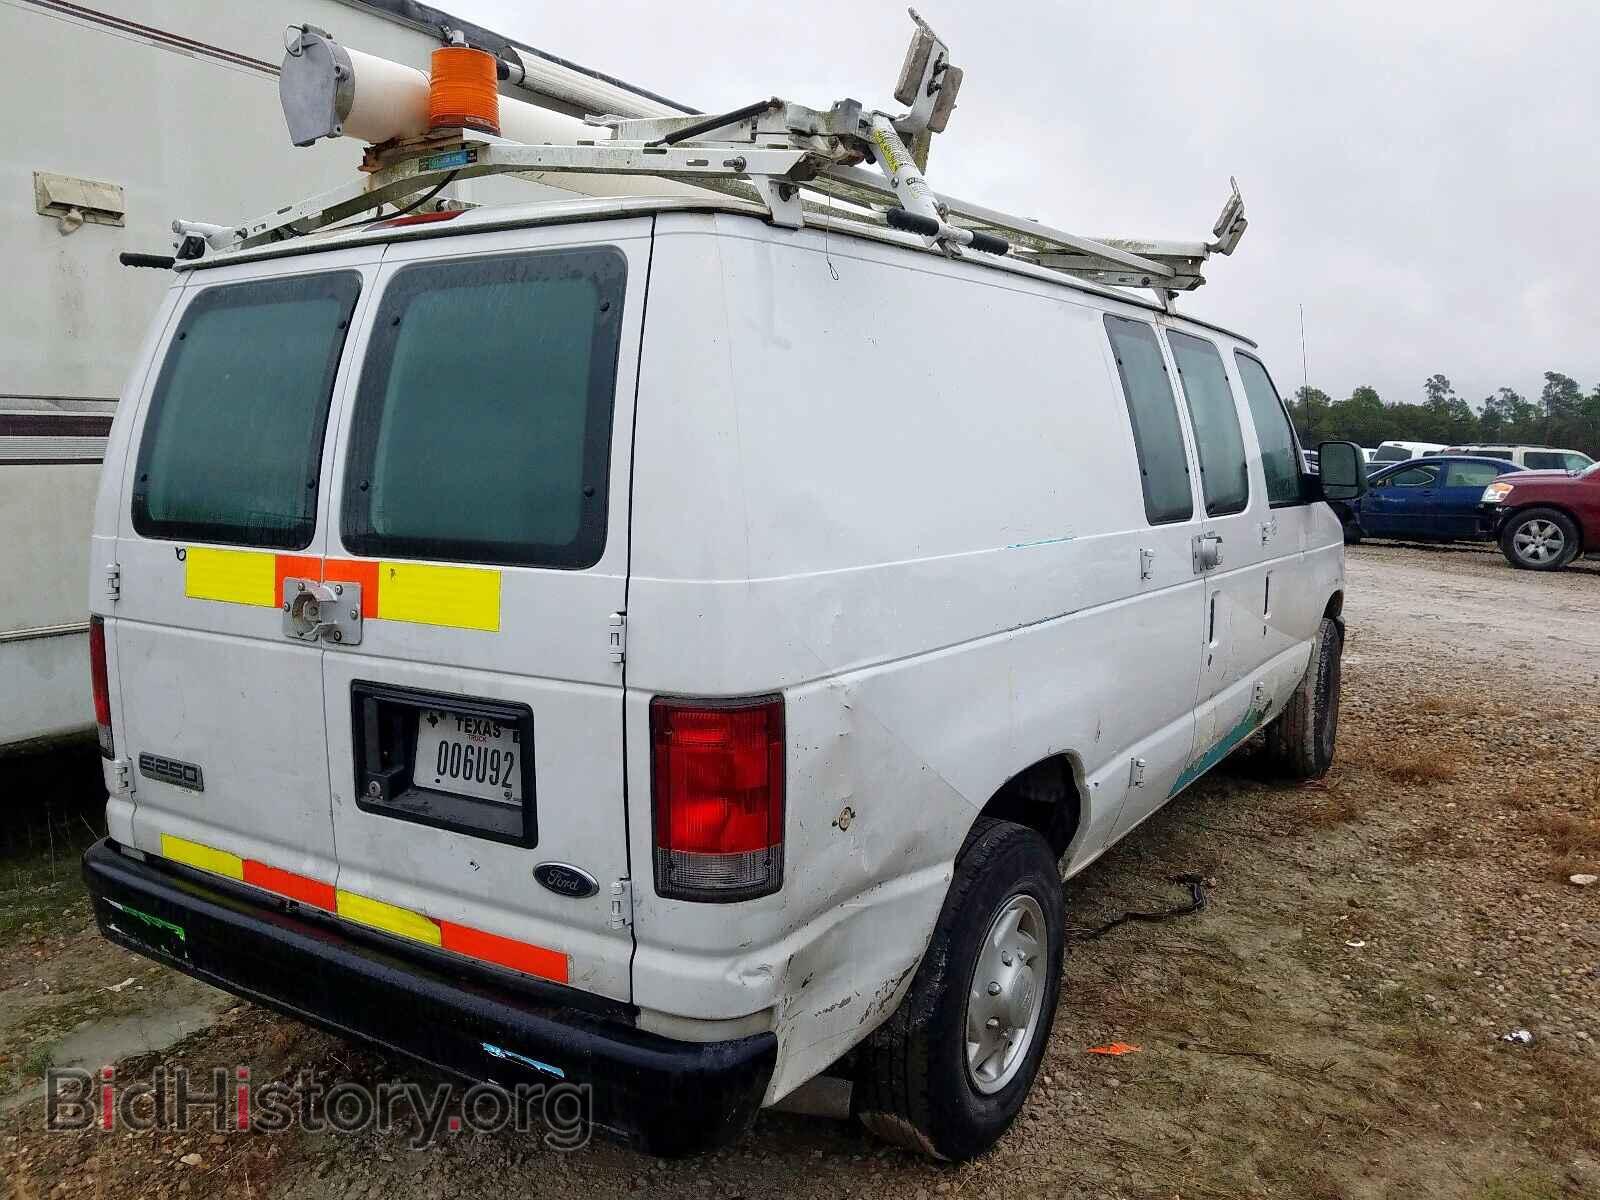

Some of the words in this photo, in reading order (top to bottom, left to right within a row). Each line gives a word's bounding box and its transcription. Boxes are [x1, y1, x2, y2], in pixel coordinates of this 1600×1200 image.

[455, 717, 502, 739] TEXAS
[140, 754, 199, 783] E250
[436, 740, 515, 789] 006U92
[547, 869, 579, 890] Ford
